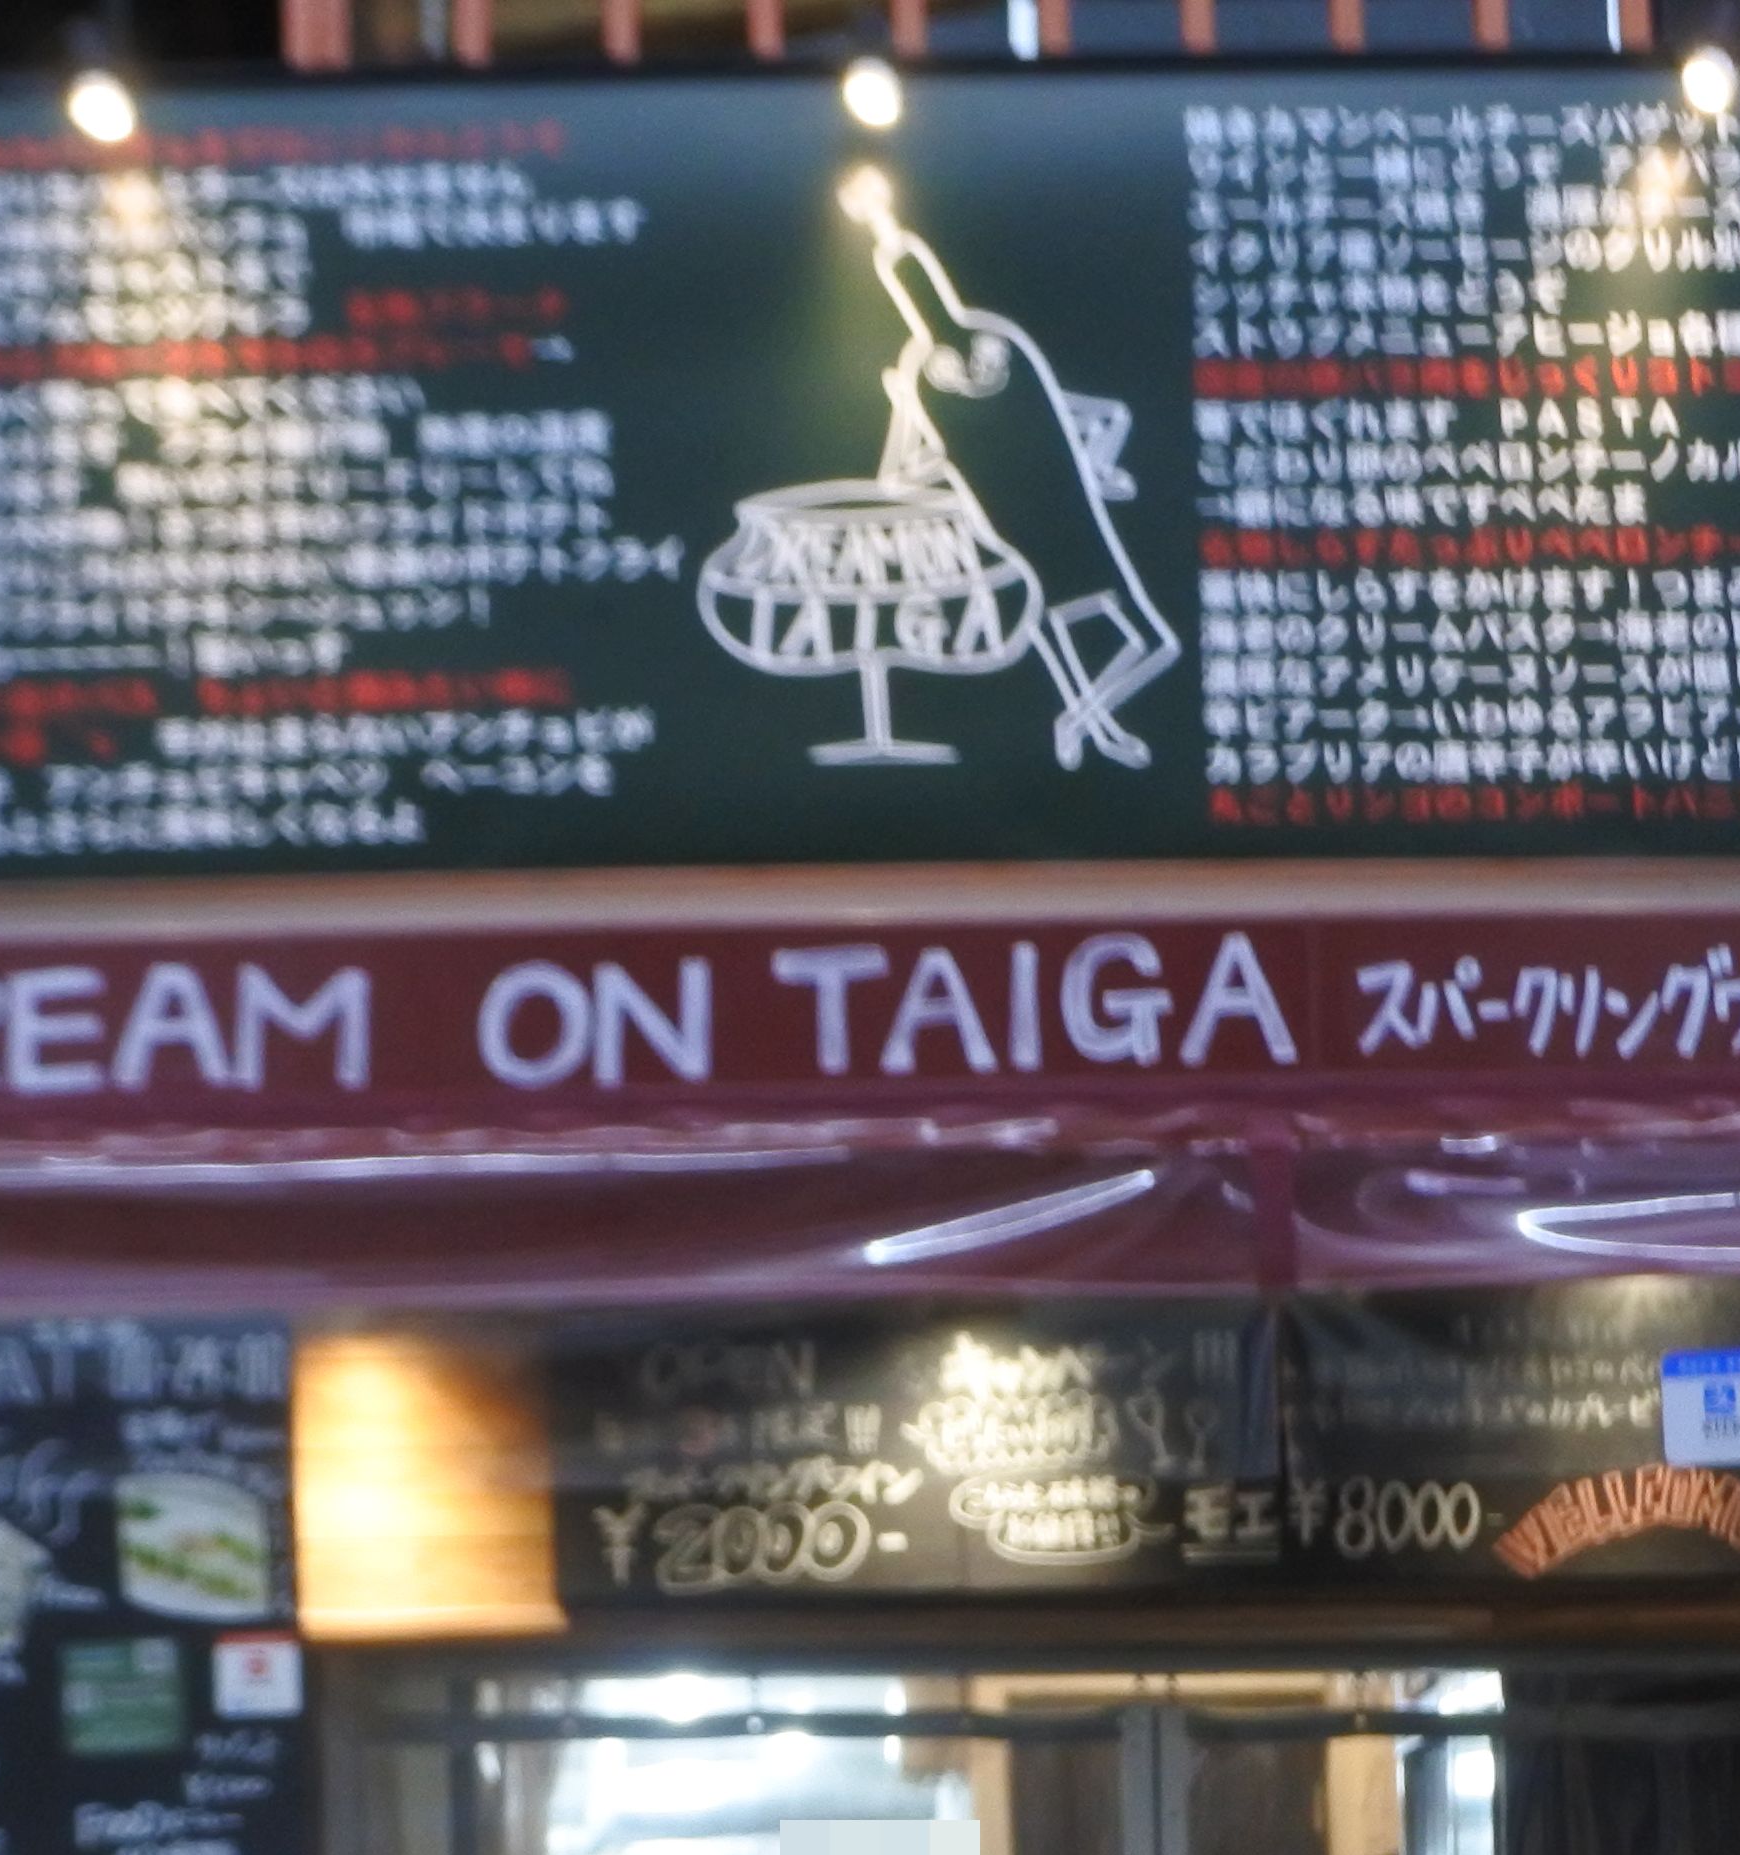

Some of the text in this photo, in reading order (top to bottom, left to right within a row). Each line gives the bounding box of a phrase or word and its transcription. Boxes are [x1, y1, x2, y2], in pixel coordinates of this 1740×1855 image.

[1498, 396, 1681, 440] PASTA
[476, 955, 714, 1090] ON
[771, 931, 1298, 1076] TAIGA
